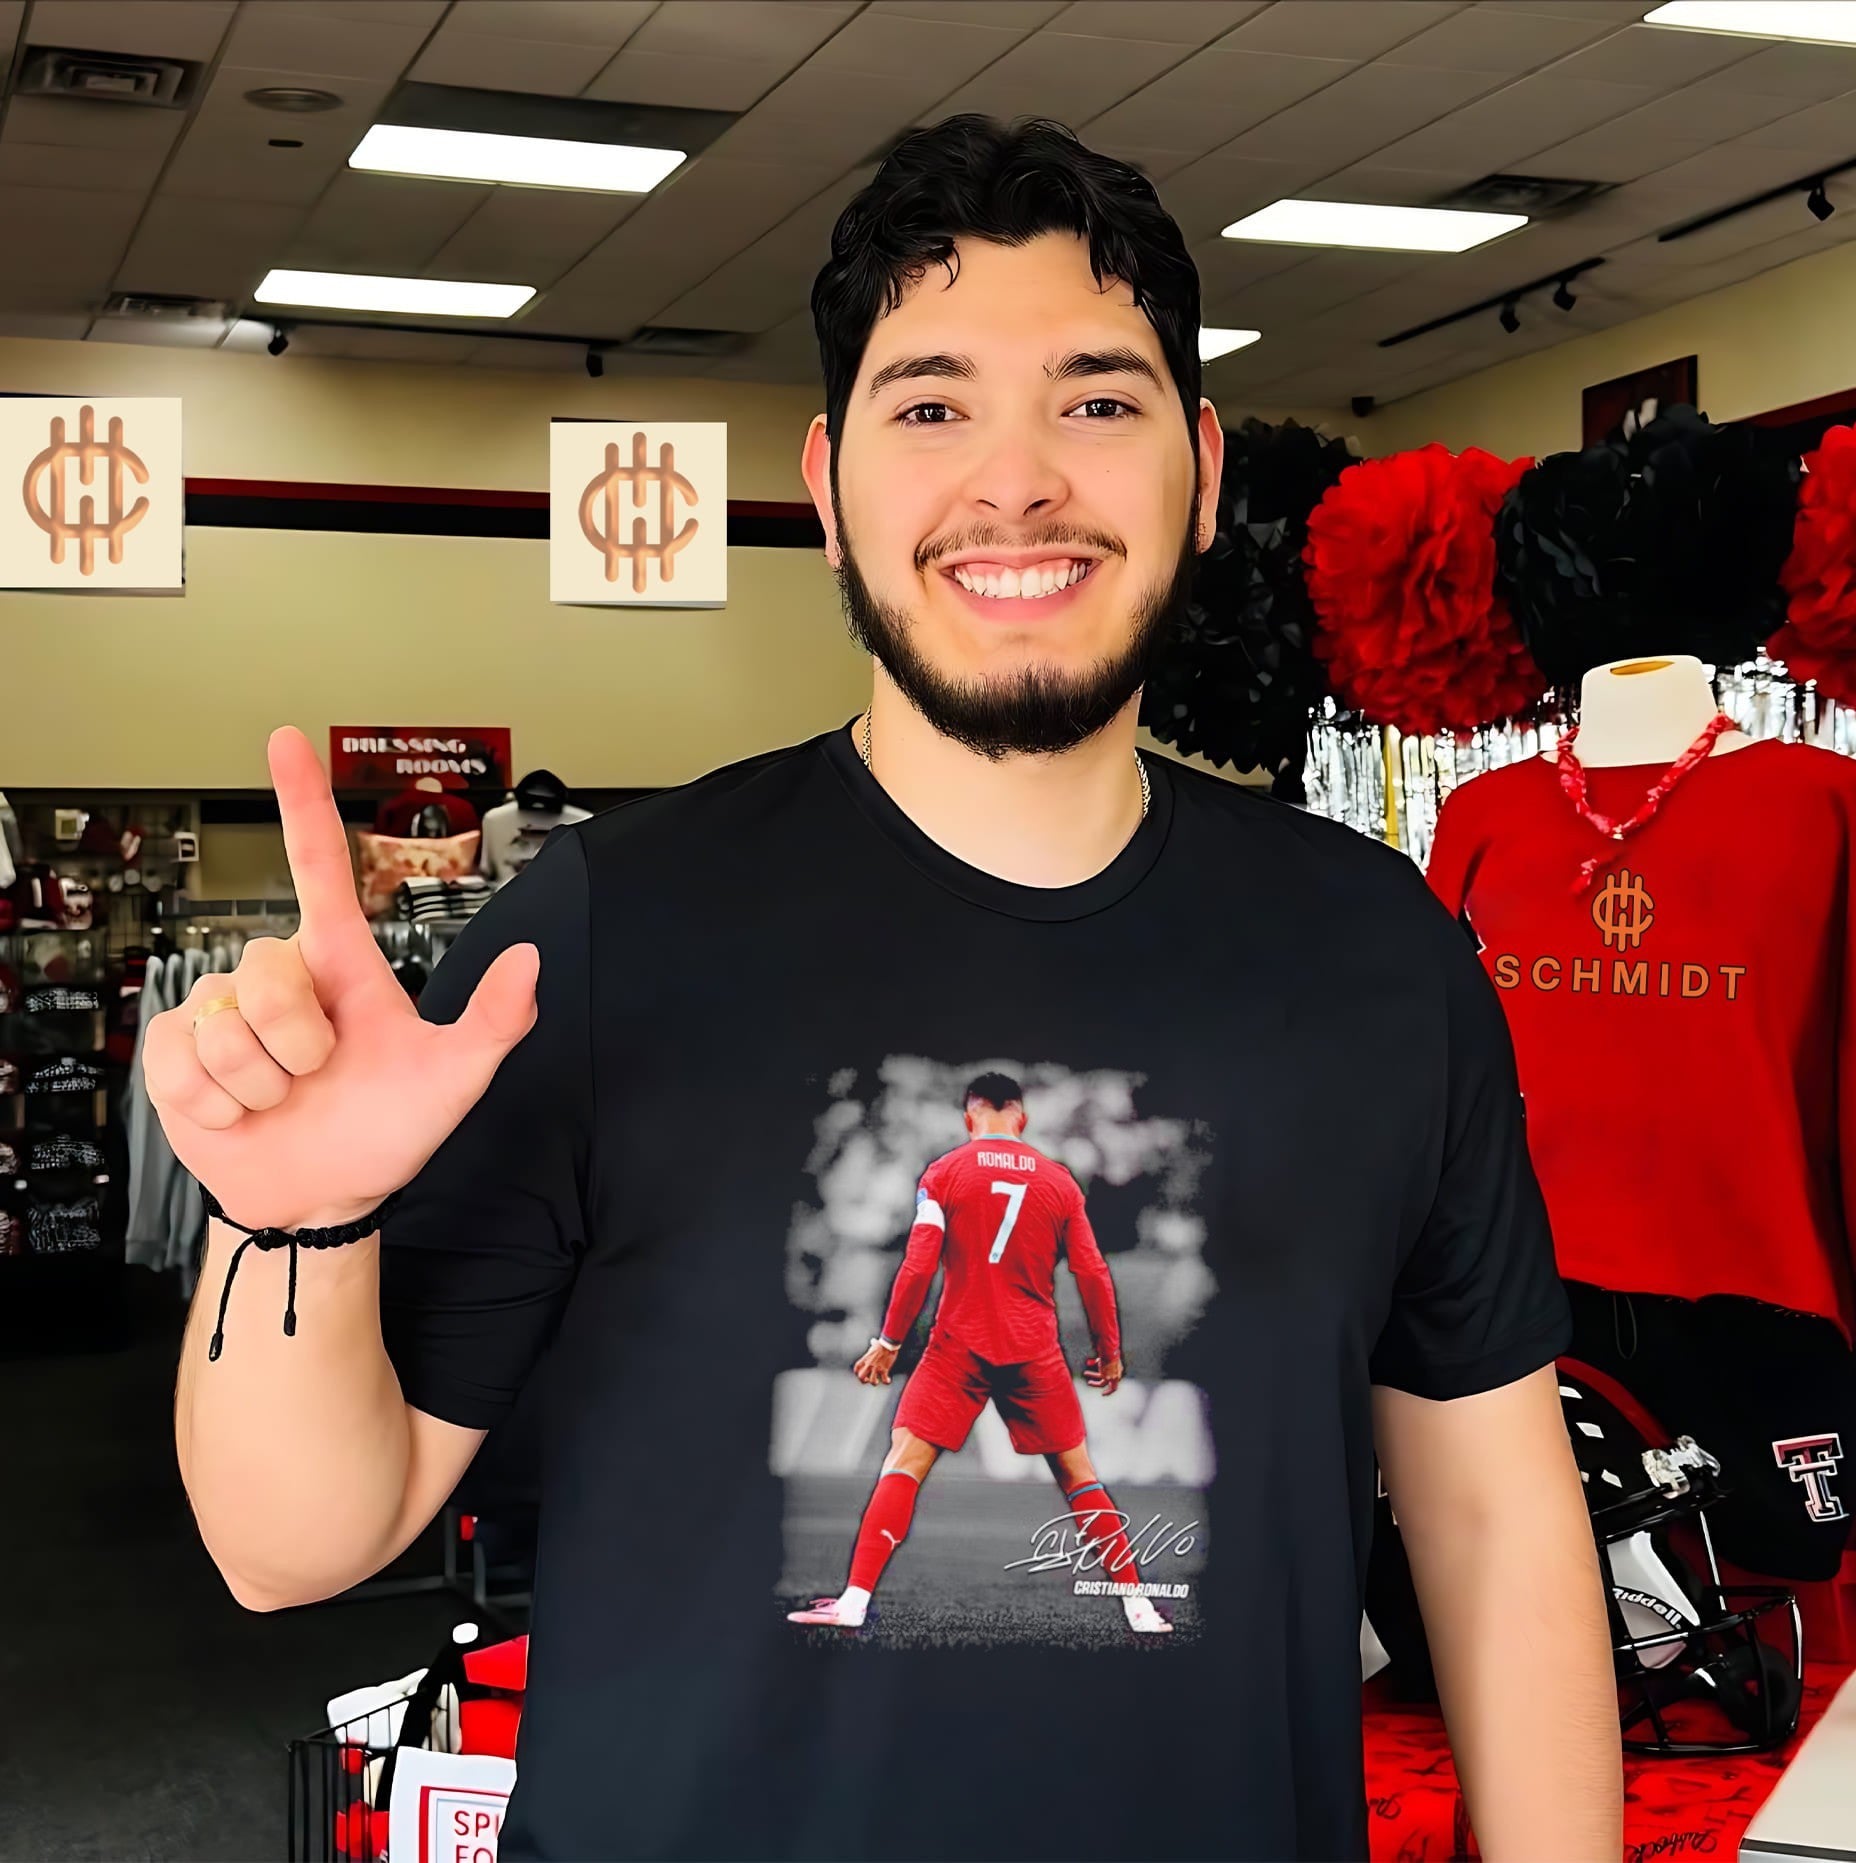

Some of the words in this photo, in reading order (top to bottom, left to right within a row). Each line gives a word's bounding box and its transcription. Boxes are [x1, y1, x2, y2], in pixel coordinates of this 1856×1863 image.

[342, 737, 467, 754] DRESSING
[396, 758, 487, 775] ROOMS
[1494, 954, 1746, 1000] SCHMIDT
[977, 1151, 1037, 1173] RONALDO
[988, 1180, 1029, 1264] 7
[1073, 1580, 1137, 1597] CRISTIANO
[1135, 1582, 1190, 1599] RONALDO
